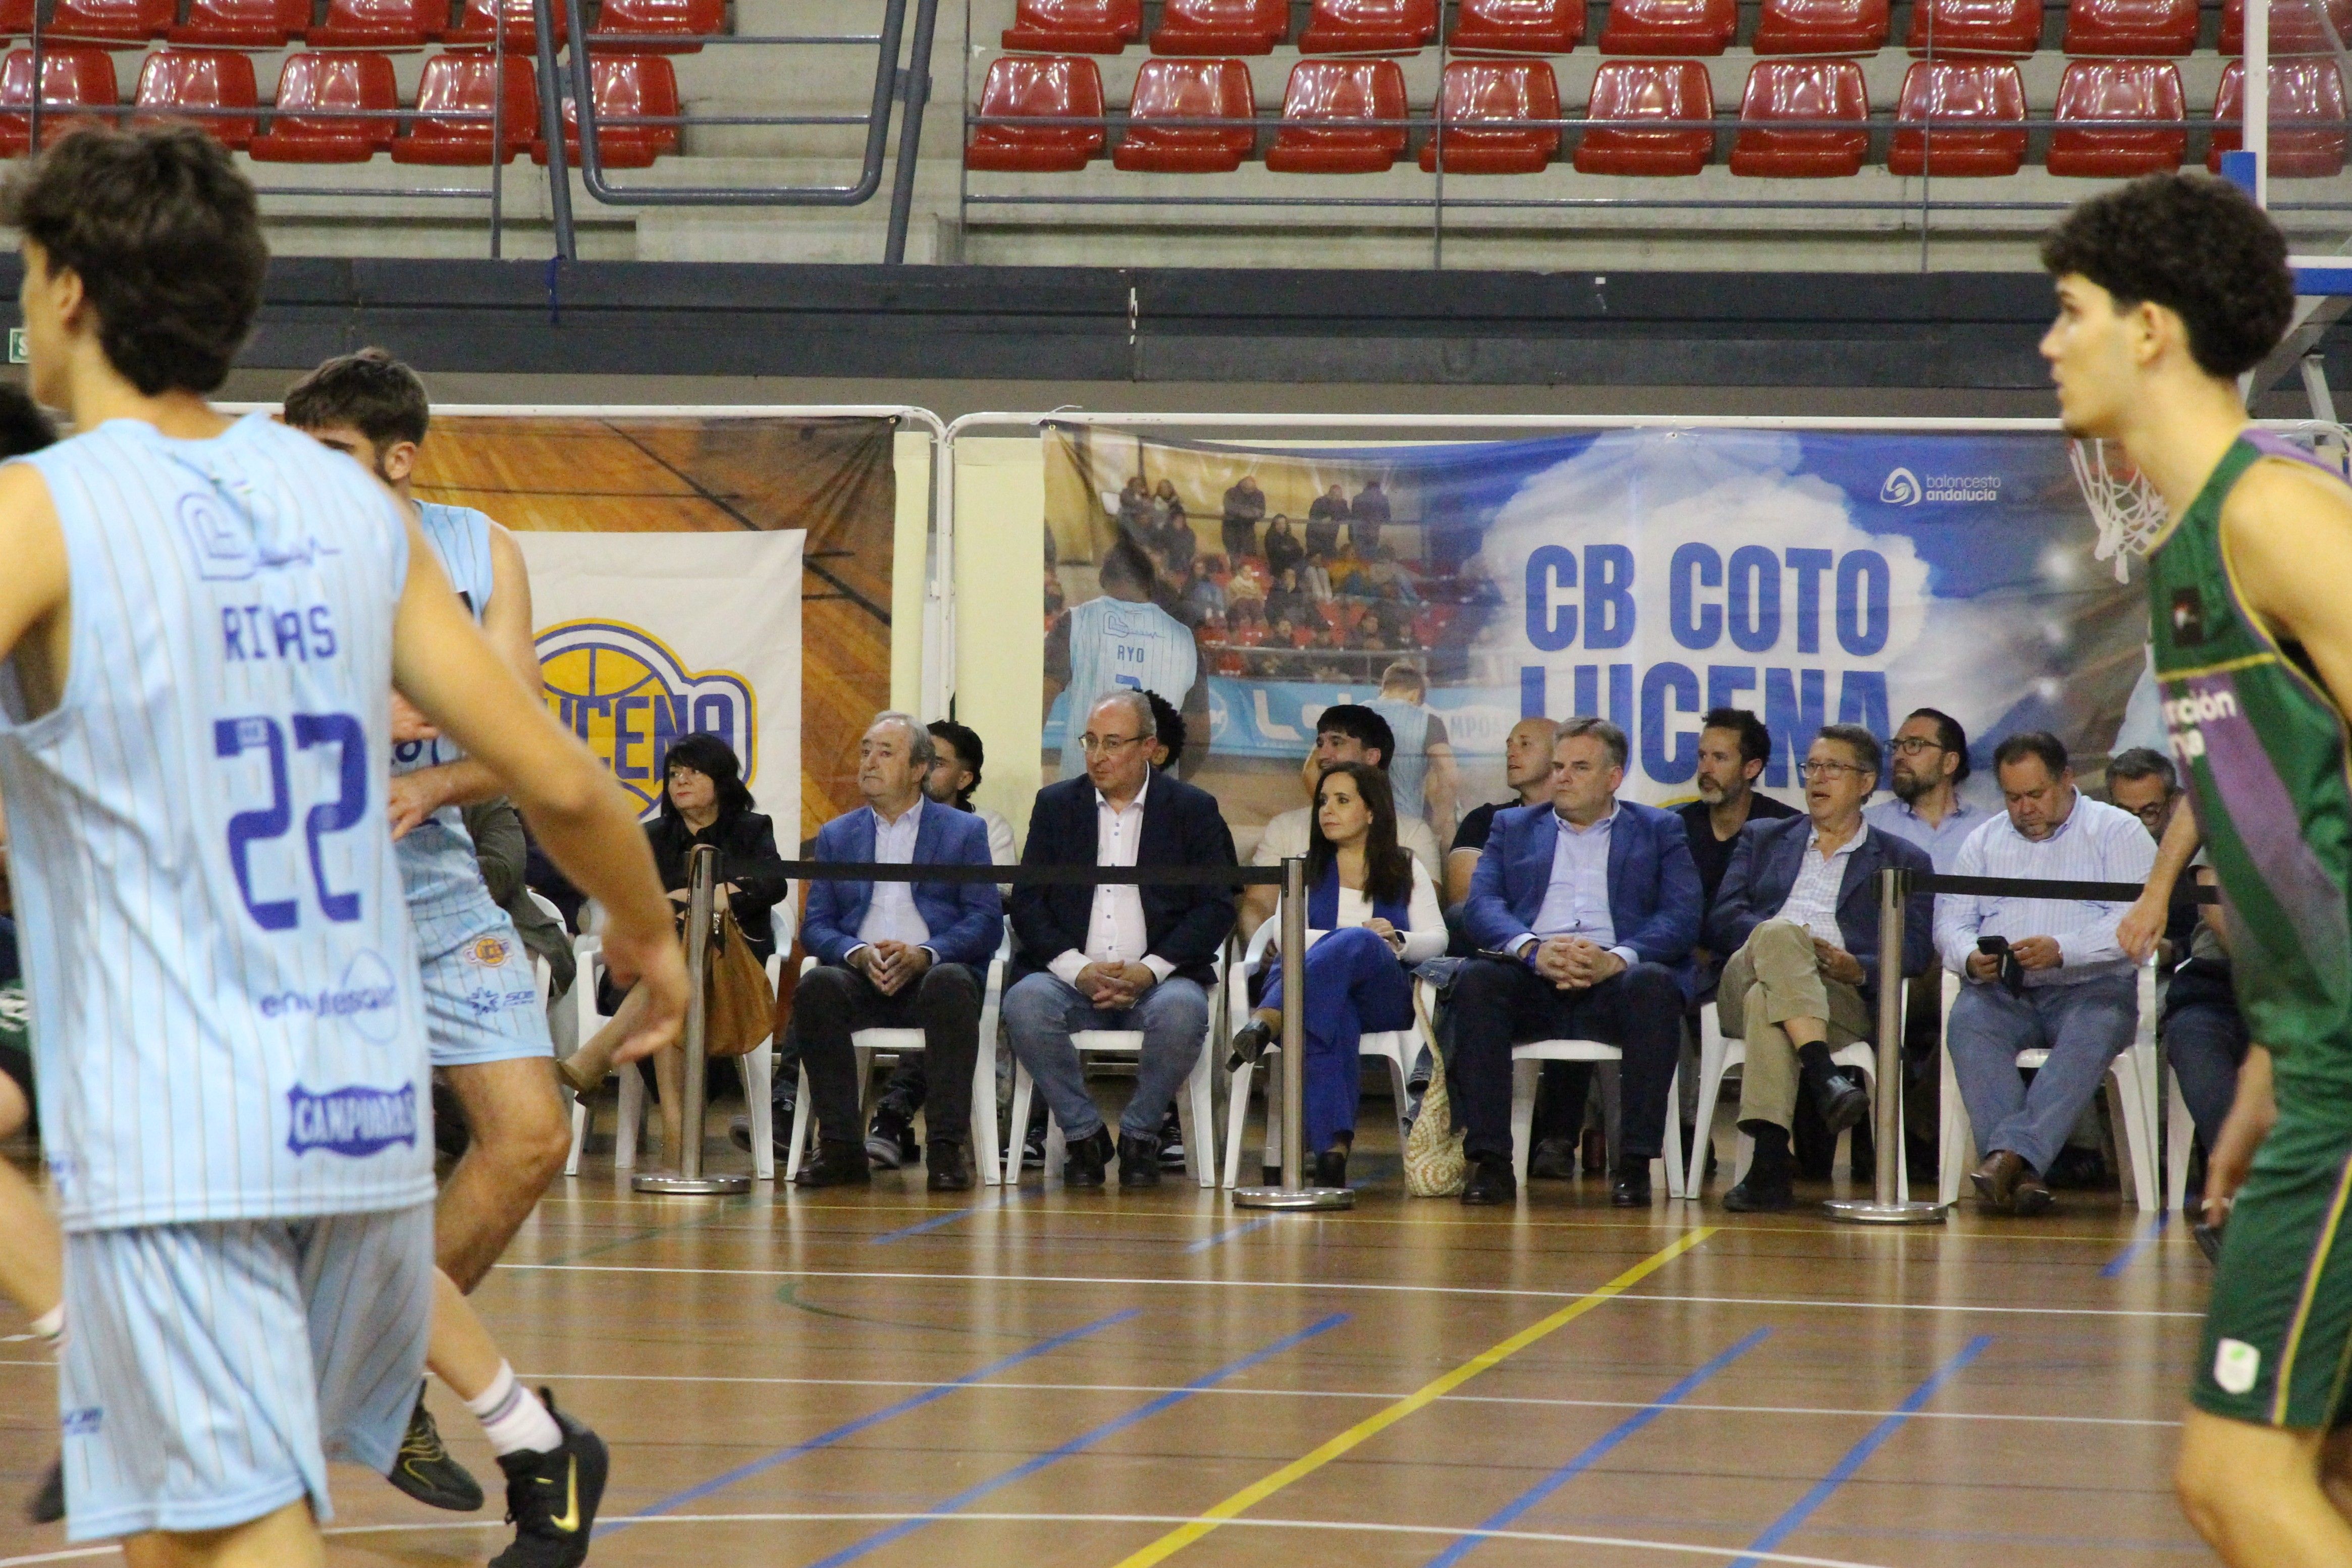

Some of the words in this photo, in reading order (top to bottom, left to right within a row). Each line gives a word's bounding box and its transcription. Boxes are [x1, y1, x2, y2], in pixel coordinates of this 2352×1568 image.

[1926, 474, 2001, 488] baloncesto
[222, 605, 337, 662] RIAS
[1526, 545, 1636, 652] CB
[1670, 542, 1890, 656] COTO
[544, 694, 734, 786] CENA
[213, 713, 367, 930] 22
